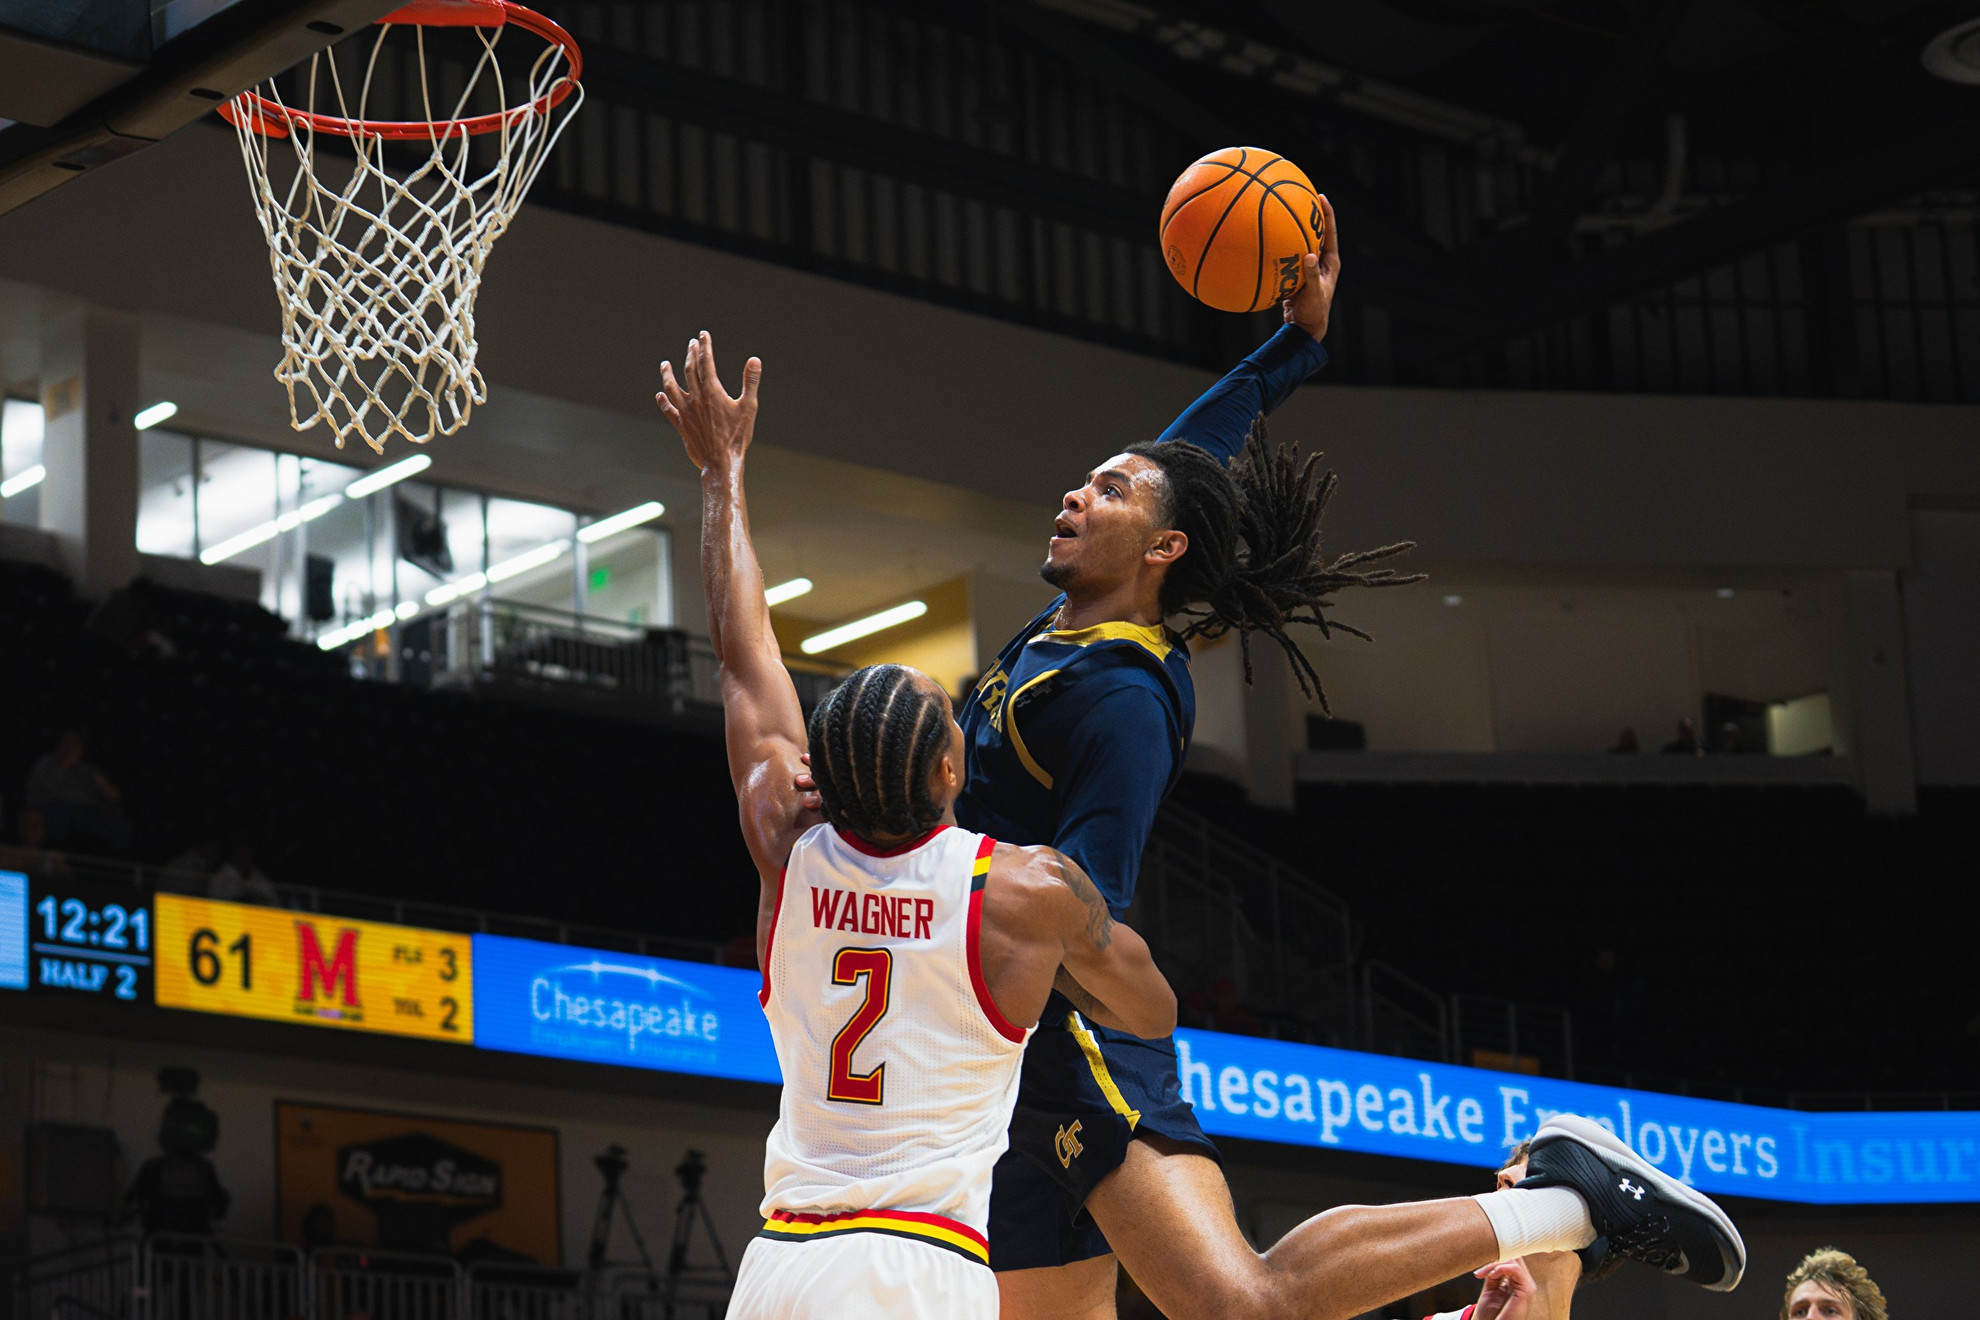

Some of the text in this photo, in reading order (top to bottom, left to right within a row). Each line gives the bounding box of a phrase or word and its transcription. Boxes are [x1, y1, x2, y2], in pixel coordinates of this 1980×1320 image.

[37, 894, 149, 951] 12:21
[810, 886, 934, 940] WAGNER
[40, 958, 137, 1000] HALF 2
[189, 927, 253, 991] 61
[439, 948, 459, 982] 3
[439, 996, 460, 1032] 2
[531, 978, 718, 1051] Chesapeake
[827, 946, 893, 1106] 2
[1177, 1039, 1980, 1186] hesapeake Eloyers Insur
